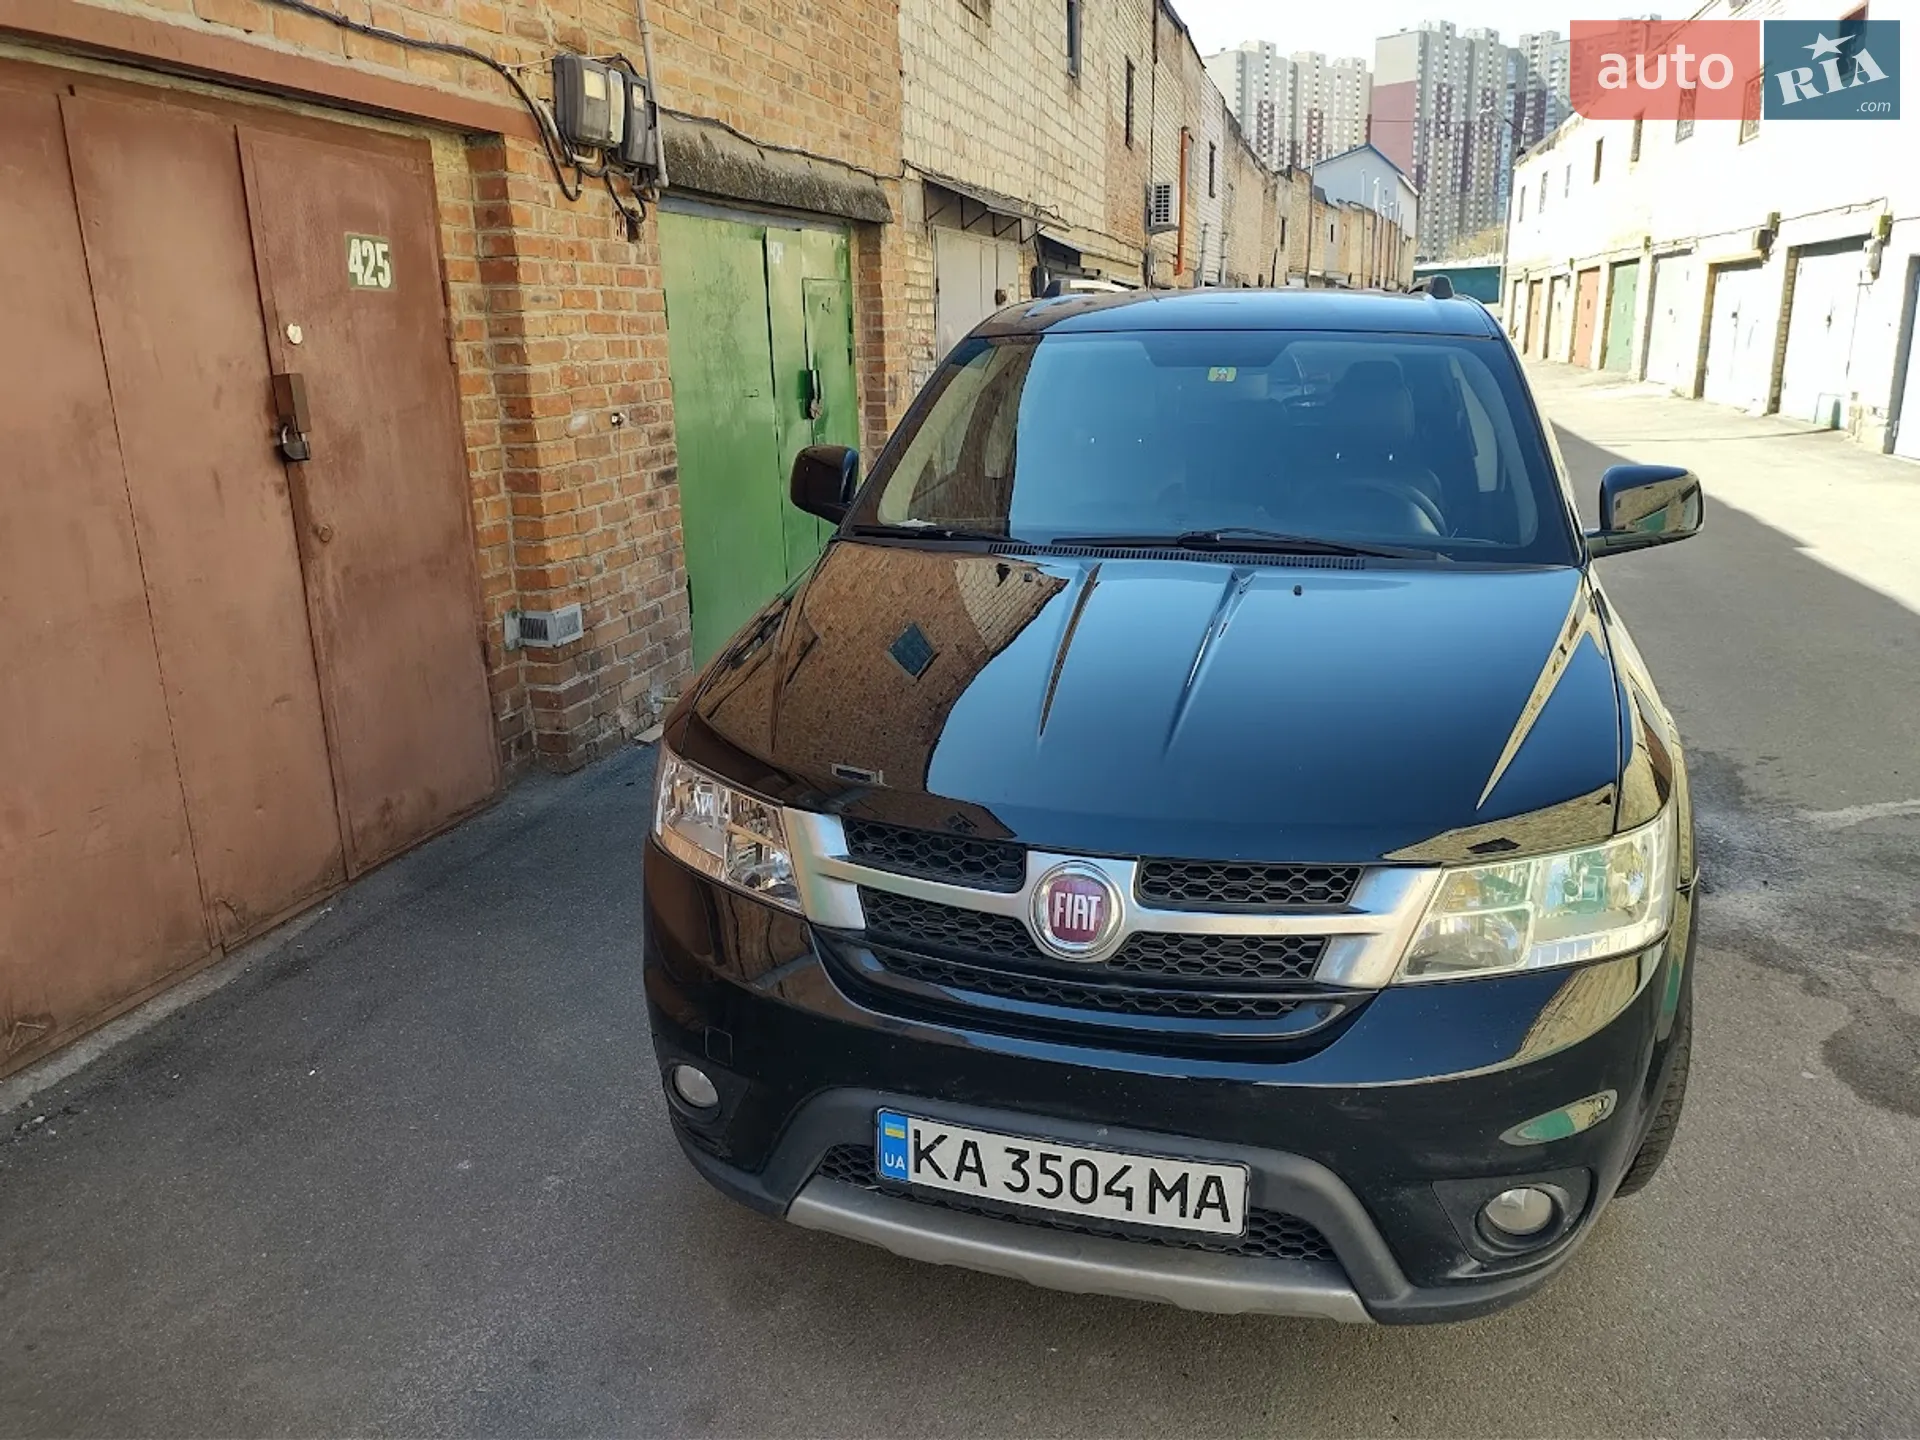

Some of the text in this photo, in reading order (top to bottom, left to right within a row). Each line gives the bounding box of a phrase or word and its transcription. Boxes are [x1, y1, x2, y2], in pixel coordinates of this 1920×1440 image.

[348, 238, 392, 288] 425
[1053, 891, 1102, 931] FIAT
[884, 1152, 906, 1171] UA
[912, 1128, 1231, 1223] KA 3504 MA
